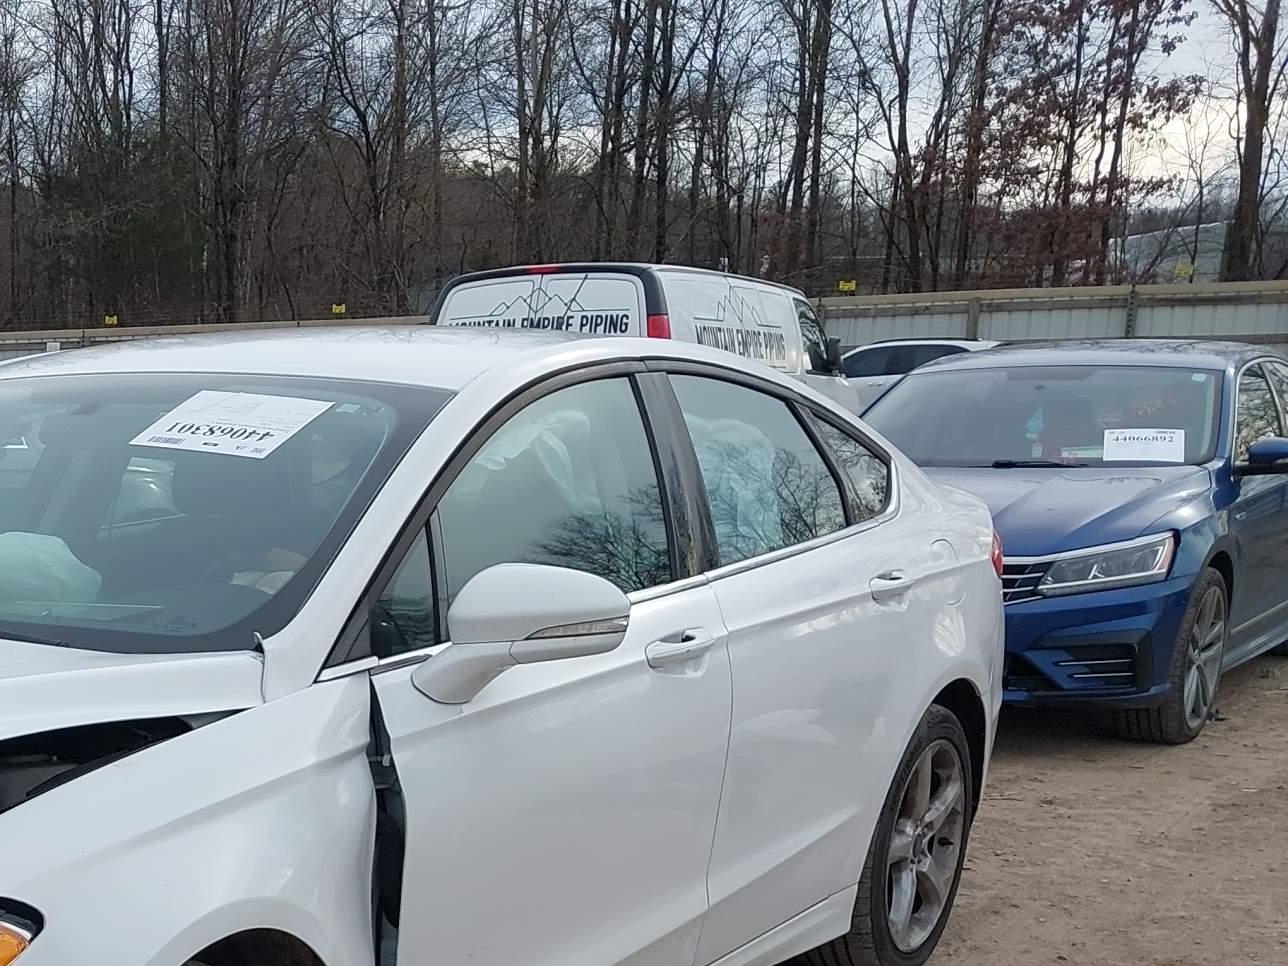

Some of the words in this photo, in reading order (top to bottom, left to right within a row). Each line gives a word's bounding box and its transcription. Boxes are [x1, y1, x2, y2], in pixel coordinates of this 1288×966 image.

[579, 314, 630, 334] PIPING
[735, 328, 764, 359] EMPIRE
[166, 422, 275, 441] 44068301
